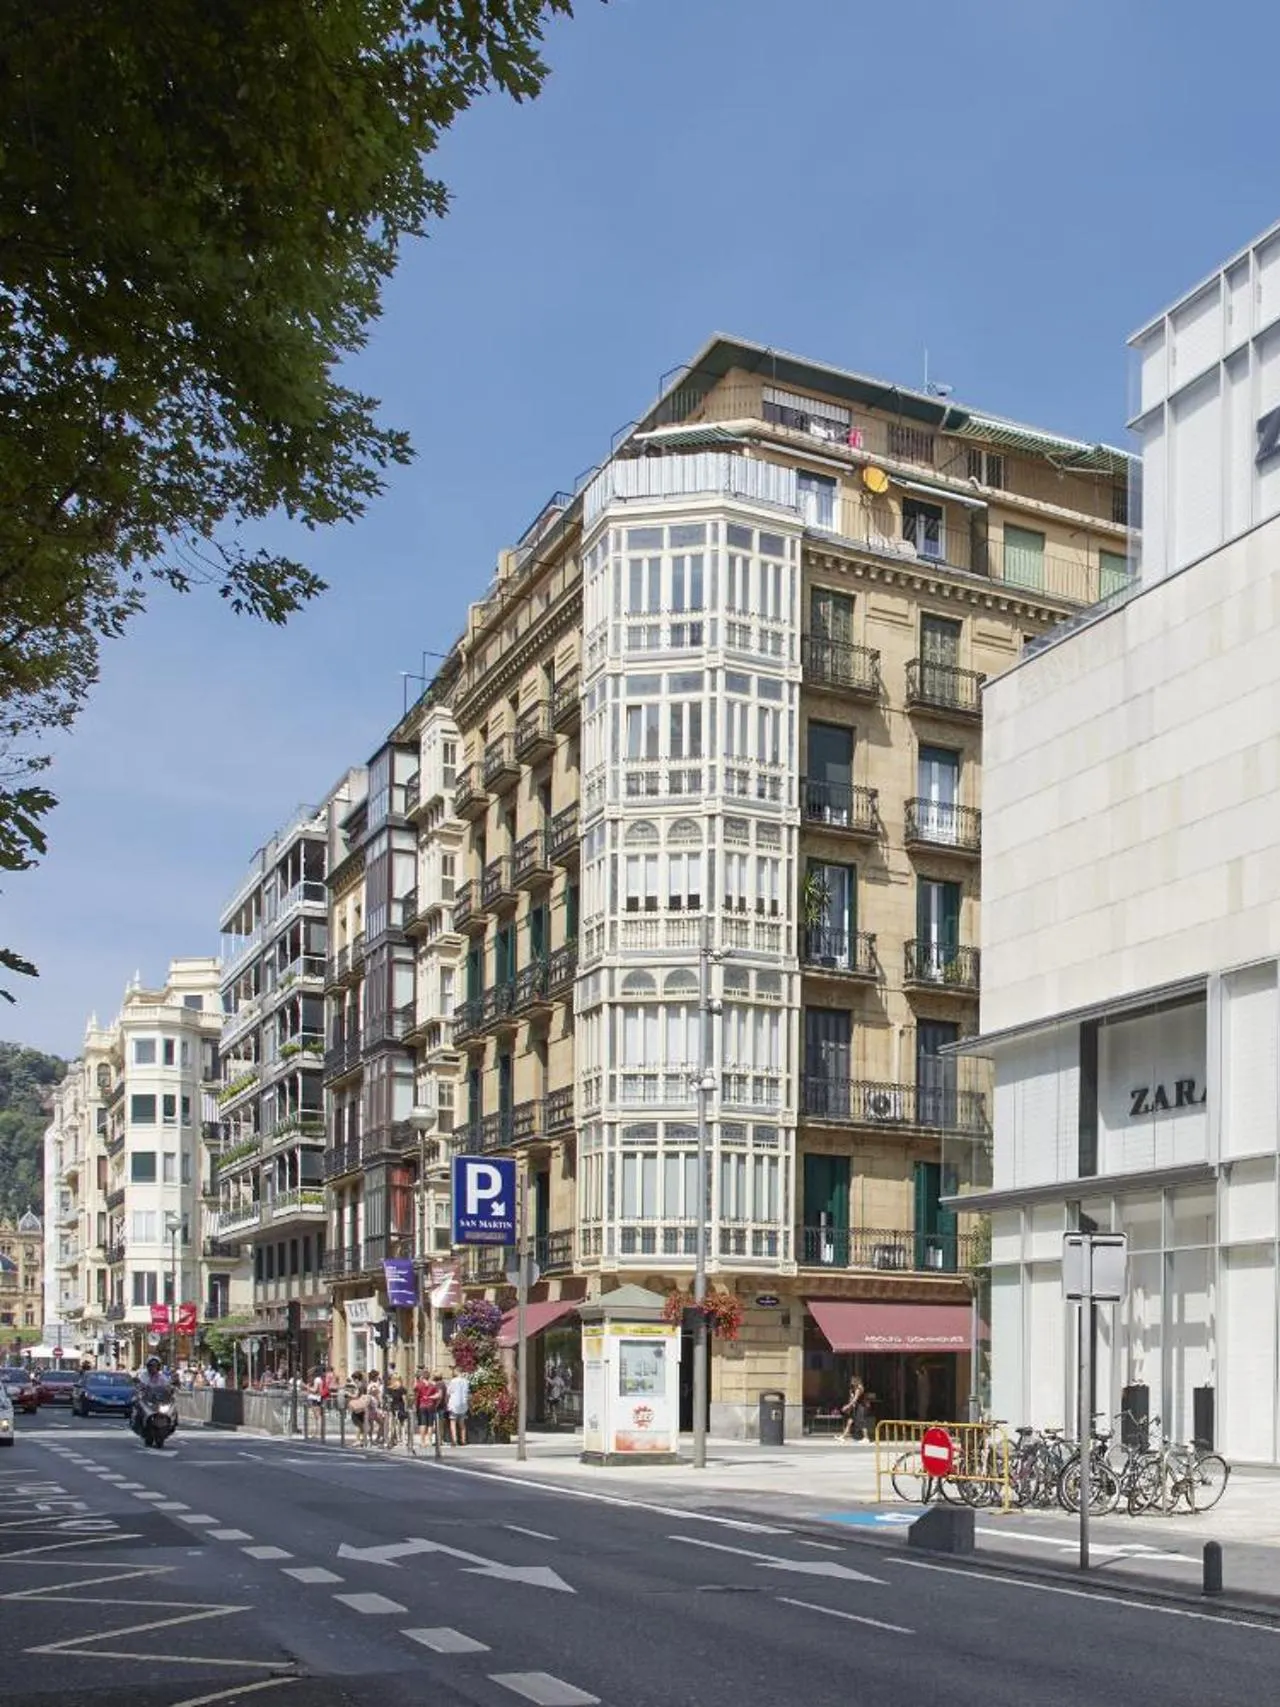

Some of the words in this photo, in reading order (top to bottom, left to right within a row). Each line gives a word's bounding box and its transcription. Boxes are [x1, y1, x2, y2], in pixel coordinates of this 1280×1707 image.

[466, 1163, 502, 1214] P
[460, 1219, 477, 1227] SAN
[479, 1220, 512, 1229] MARTIN
